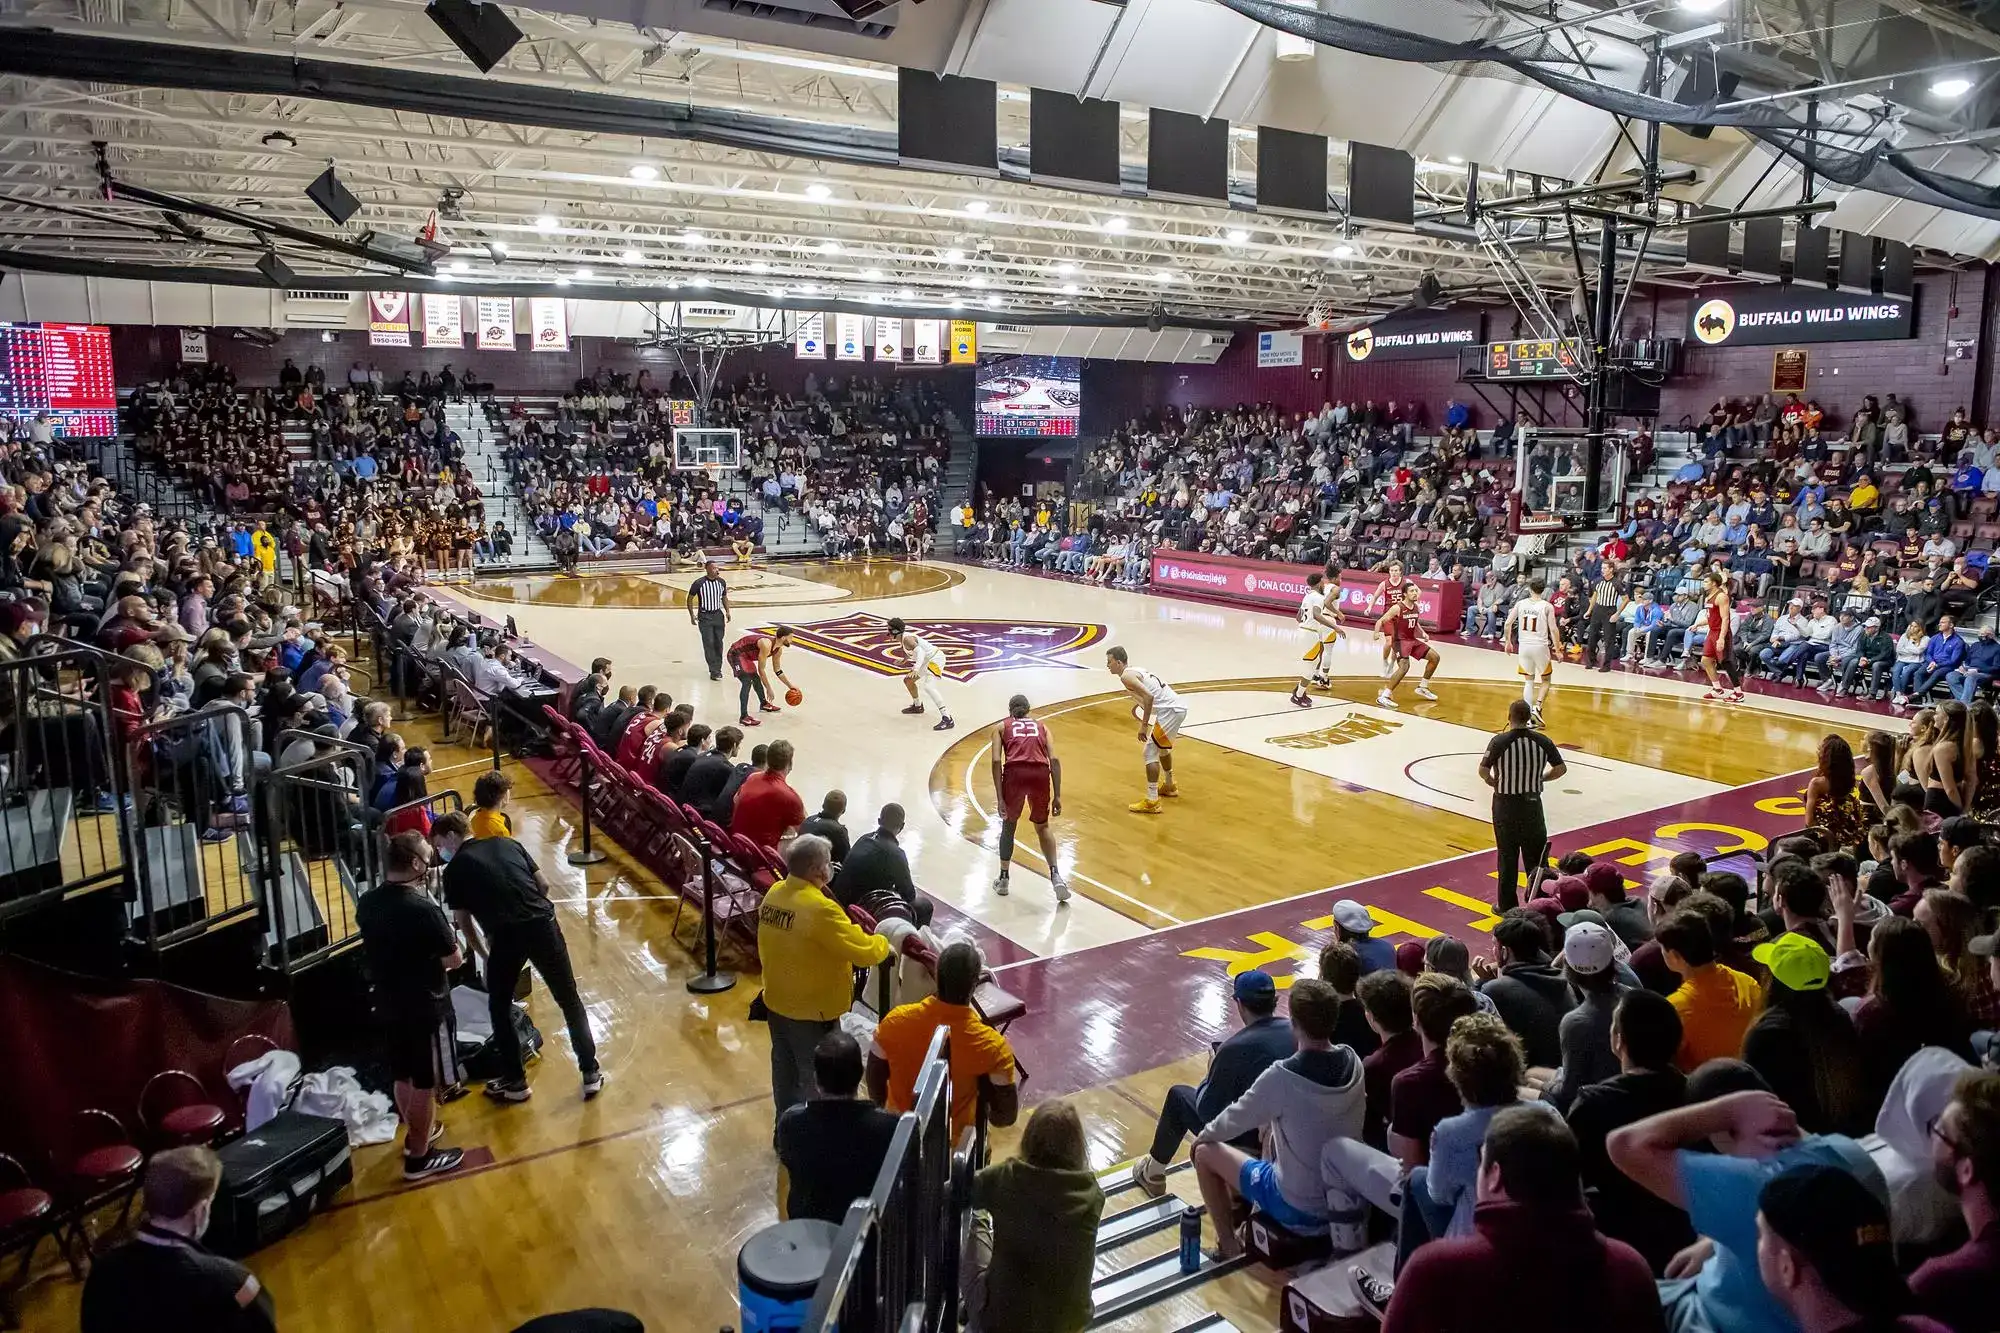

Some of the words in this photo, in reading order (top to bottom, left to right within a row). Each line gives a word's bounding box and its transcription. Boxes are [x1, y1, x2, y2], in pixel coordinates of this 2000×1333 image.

[1739, 309, 1801, 327] BUFFALO
[1806, 307, 1843, 323] WILD
[371, 322, 408, 332] GUERIN
[1375, 335, 1414, 347] BUFFALO
[1415, 333, 1439, 344] WILD
[184, 345, 203, 353] 2021
[1516, 342, 1553, 358] 15:29
[1955, 347, 1963, 358] 6
[1493, 353, 1508, 368] 53
[1536, 362, 1543, 375] 2
[67, 416, 80, 424] 50
[673, 410, 690, 424] 25
[1258, 579, 1279, 591] IONA
[1279, 582, 1311, 596] COLLEG
[1391, 593, 1402, 603] 55
[1522, 616, 1538, 632] 11
[1012, 721, 1039, 737] 23
[760, 904, 794, 929] SECURITY
[1574, 964, 1598, 974] IONA
